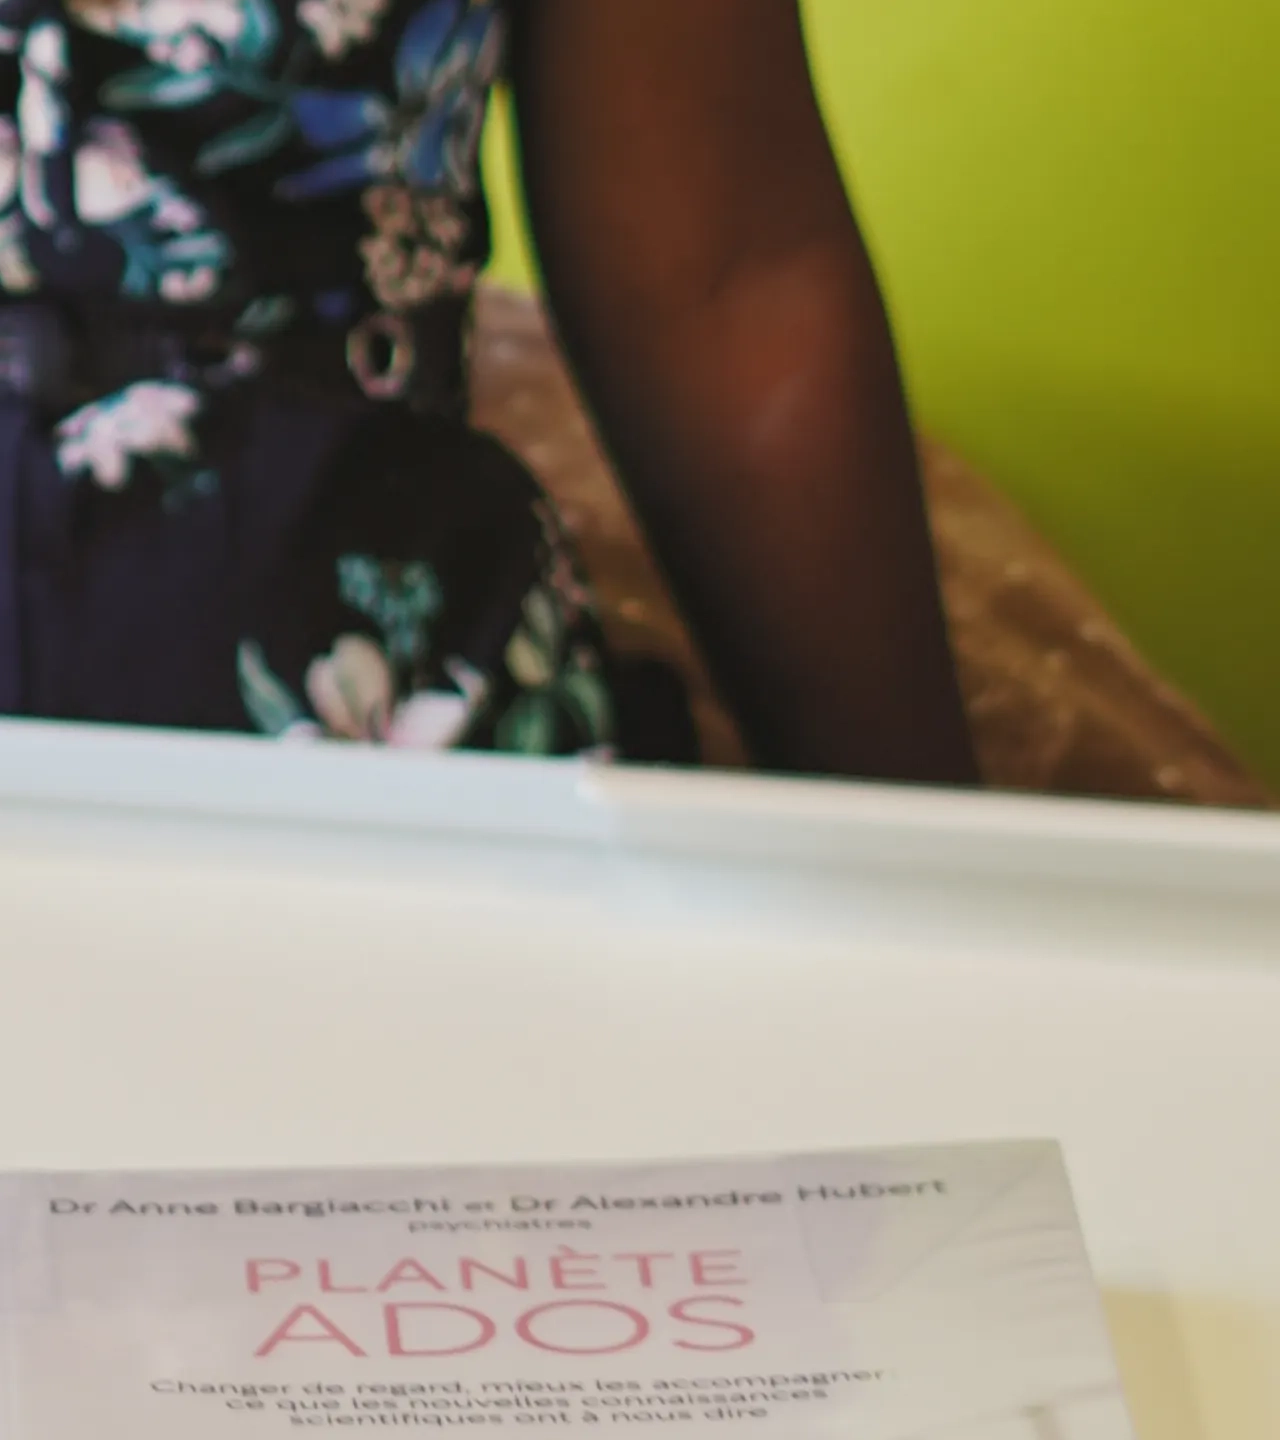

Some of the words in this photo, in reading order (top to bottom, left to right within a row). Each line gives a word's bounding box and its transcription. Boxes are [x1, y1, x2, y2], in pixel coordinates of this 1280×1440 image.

[48, 1197, 98, 1215] Dr
[108, 1198, 220, 1215] Anne
[233, 1195, 452, 1218] Bargiacchi
[510, 1194, 556, 1212] Dr
[569, 1187, 783, 1211] Alexandre
[796, 1178, 947, 1202] Hubert
[407, 1216, 593, 1234] psychiatres
[244, 1244, 749, 1293] PLANÈTE
[252, 1294, 756, 1358] ADOS
[149, 1379, 292, 1397] Changer
[302, 1380, 346, 1395] de
[355, 1380, 471, 1397] regard,
[480, 1377, 585, 1394] mieux
[594, 1377, 642, 1392] les
[224, 1398, 265, 1411] ce
[275, 1397, 341, 1414] que
[352, 1396, 398, 1411] les
[408, 1393, 571, 1411] nouvelles
[580, 1387, 829, 1409] connaissances
[289, 1410, 504, 1428] scientifiques
[513, 1411, 568, 1426] ont
[610, 1407, 692, 1423] nous
[703, 1404, 769, 1420] dire
